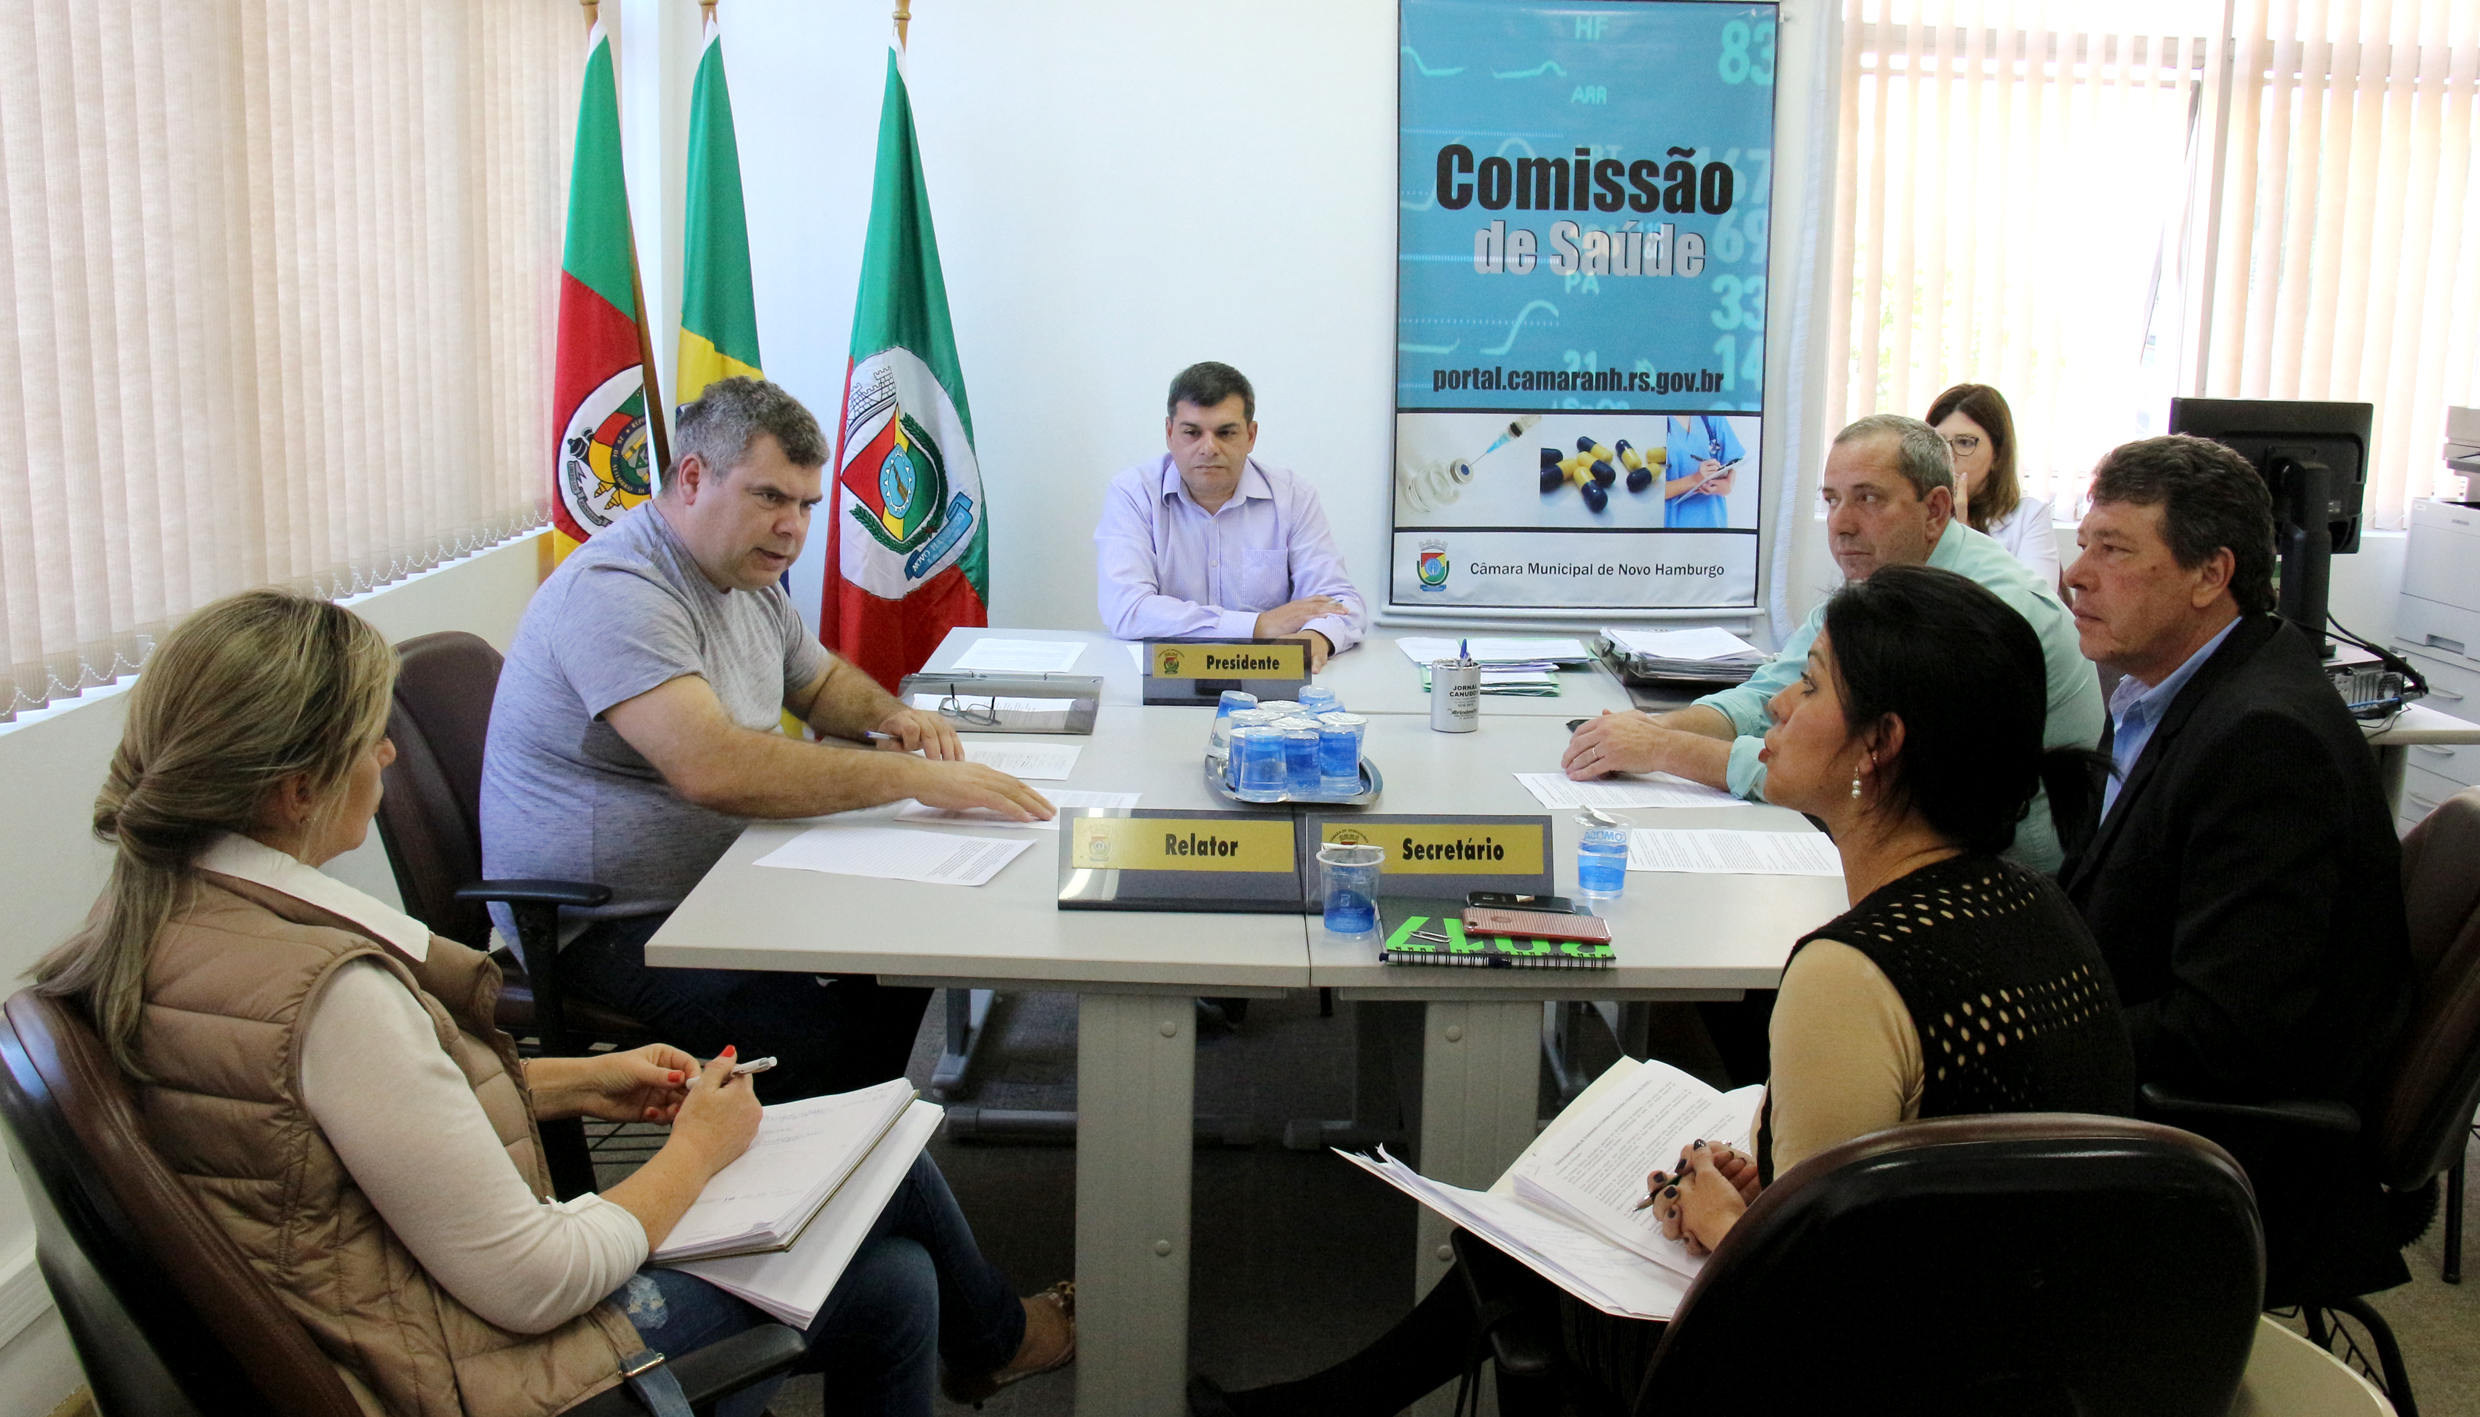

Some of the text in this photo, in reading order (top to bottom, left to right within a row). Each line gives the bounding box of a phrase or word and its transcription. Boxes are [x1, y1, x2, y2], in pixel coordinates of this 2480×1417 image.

[1575, 16, 1608, 40] HF
[1719, 20, 1775, 86] 83
[1436, 144, 1734, 215] Comissão
[1474, 220, 1537, 276] de
[1549, 220, 1706, 279] Saúde
[1563, 271, 1600, 295] PA
[1711, 273, 1767, 331] 33
[1433, 366, 1724, 396] portal.camaranh.rs.gov.br
[911, 549, 931, 572] NOVO
[1470, 562, 1725, 578] Câmara Municipal de Novo Hamburgo
[1206, 654, 1280, 670] Presidente
[1165, 833, 1238, 857] Relator
[1402, 837, 1504, 861] Secretário
